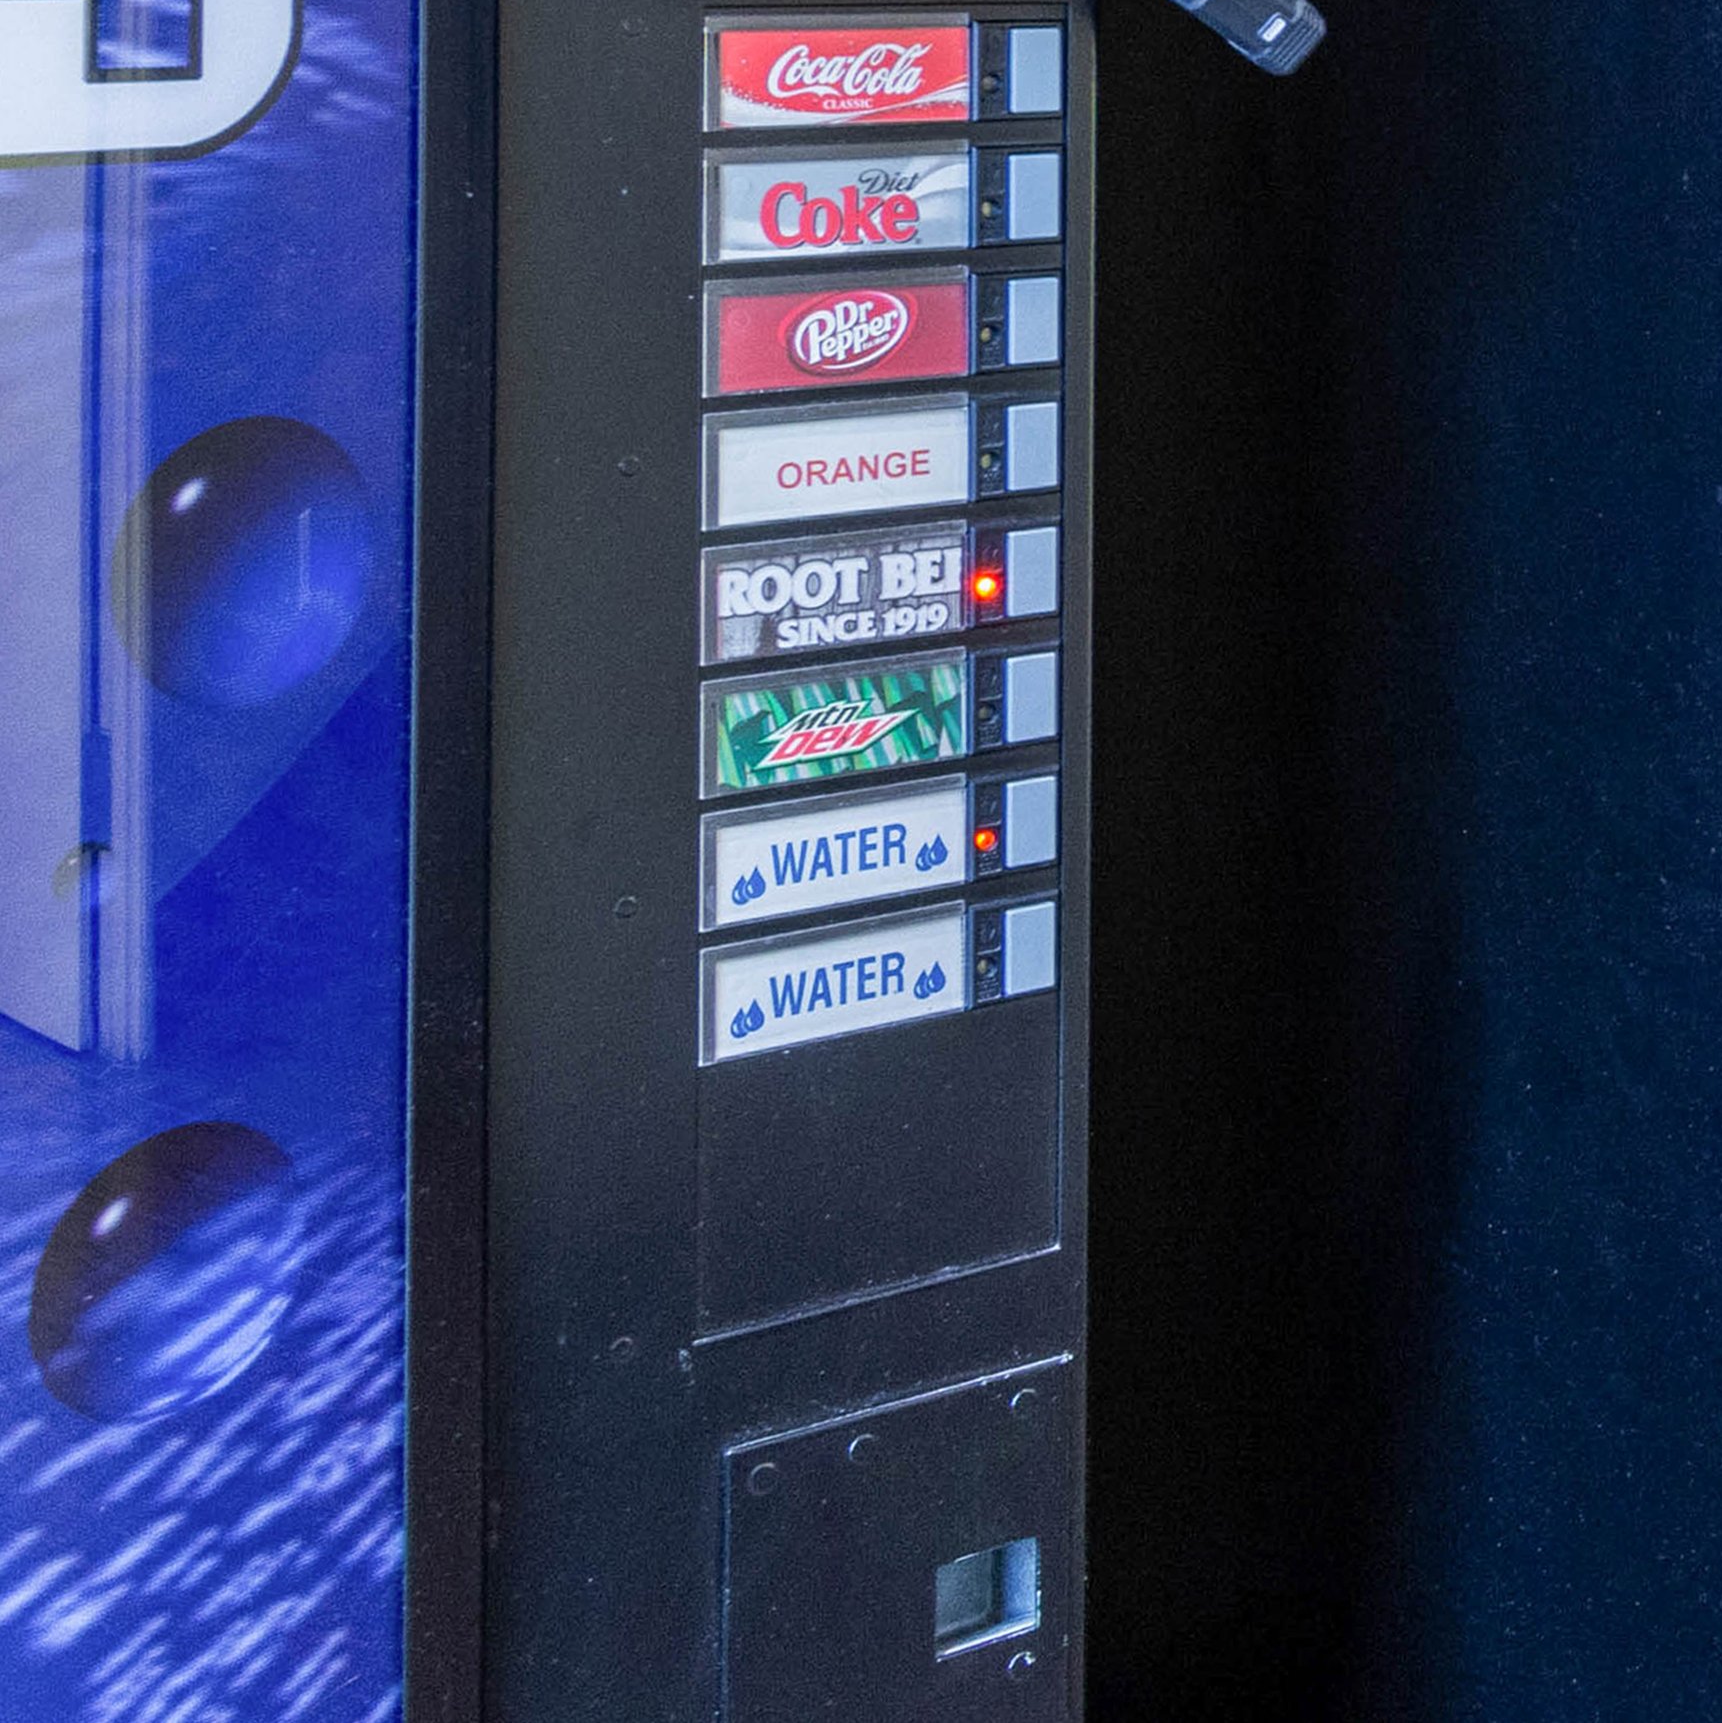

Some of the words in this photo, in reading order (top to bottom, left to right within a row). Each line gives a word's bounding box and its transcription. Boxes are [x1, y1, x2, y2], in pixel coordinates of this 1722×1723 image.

[766, 41, 934, 98] Coca-Cola
[822, 96, 874, 110] CLASSIC
[858, 168, 919, 195] Diet
[759, 181, 922, 250] Coke
[795, 306, 902, 366] Pepper
[836, 299, 874, 328] Dr
[777, 448, 931, 490] ORANGE
[718, 556, 869, 619] ROOT
[777, 611, 876, 649] SINCE
[881, 603, 949, 637] 1919
[791, 700, 862, 733] Mtn
[771, 823, 907, 888] WATER
[768, 952, 906, 1018] WATER
